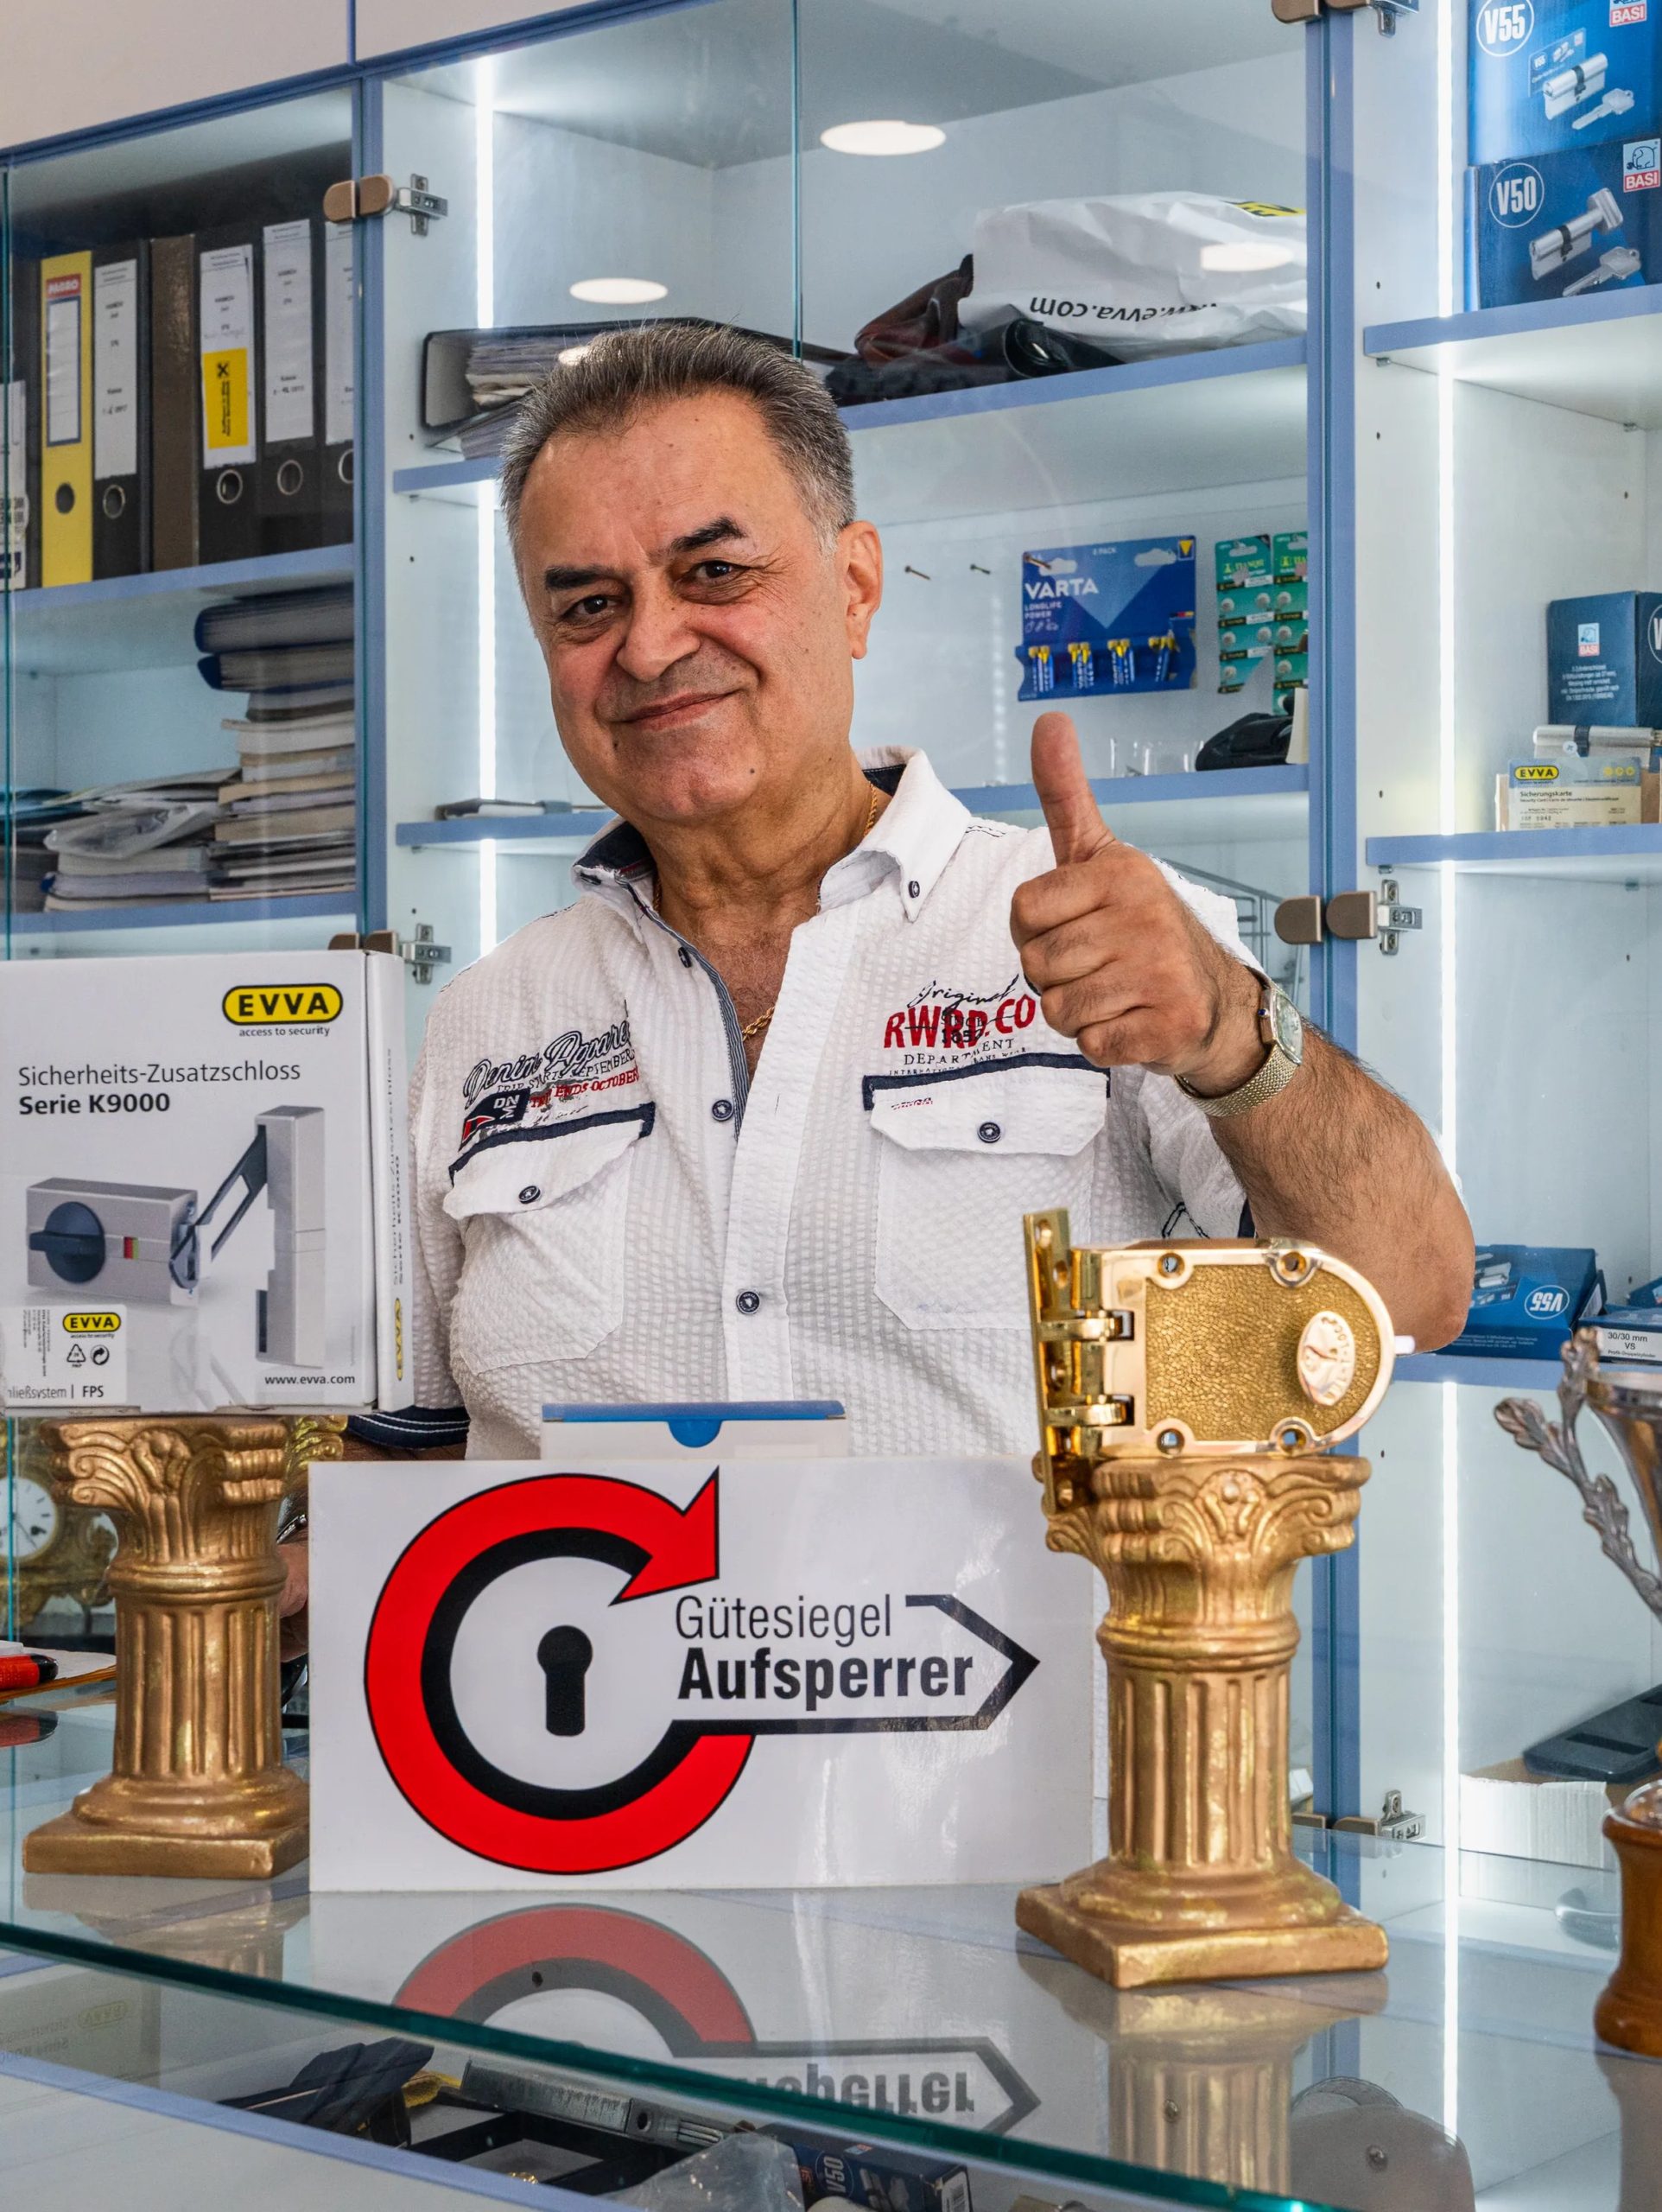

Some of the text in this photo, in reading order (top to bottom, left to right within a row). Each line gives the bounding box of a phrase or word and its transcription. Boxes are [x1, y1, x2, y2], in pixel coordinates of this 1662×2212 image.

[1484, 3, 1526, 44] V55
[1610, 5, 1645, 24] BASI
[1625, 172, 1659, 189] BASI
[1495, 175, 1538, 216] V50
[1024, 577, 1099, 600] VARTA
[1024, 601, 1063, 611] LONGLIFE
[1024, 610, 1052, 620] POWER
[1519, 768, 1554, 778] EVVA
[238, 992, 330, 1016] EVVA
[239, 1026, 330, 1037] access to security
[904, 1039, 1014, 1065] DEPARTMENT
[18, 1060, 301, 1087] Sicherheits-Zusatzschloss
[463, 1053, 542, 1111] Denim
[555, 1082, 589, 1098] ENDS
[19, 1093, 170, 1116] Serie K9000
[1529, 1292, 1564, 1313] V55
[70, 1316, 114, 1329] EVVA
[1608, 1332, 1630, 1341] 30/30
[264, 1373, 355, 1386] www.evva.com
[82, 1385, 104, 1398] FPS
[676, 1593, 891, 1648] Gütesiegel
[678, 1646, 974, 1712] Aufsperrer
[823, 2155, 847, 2194] V50
